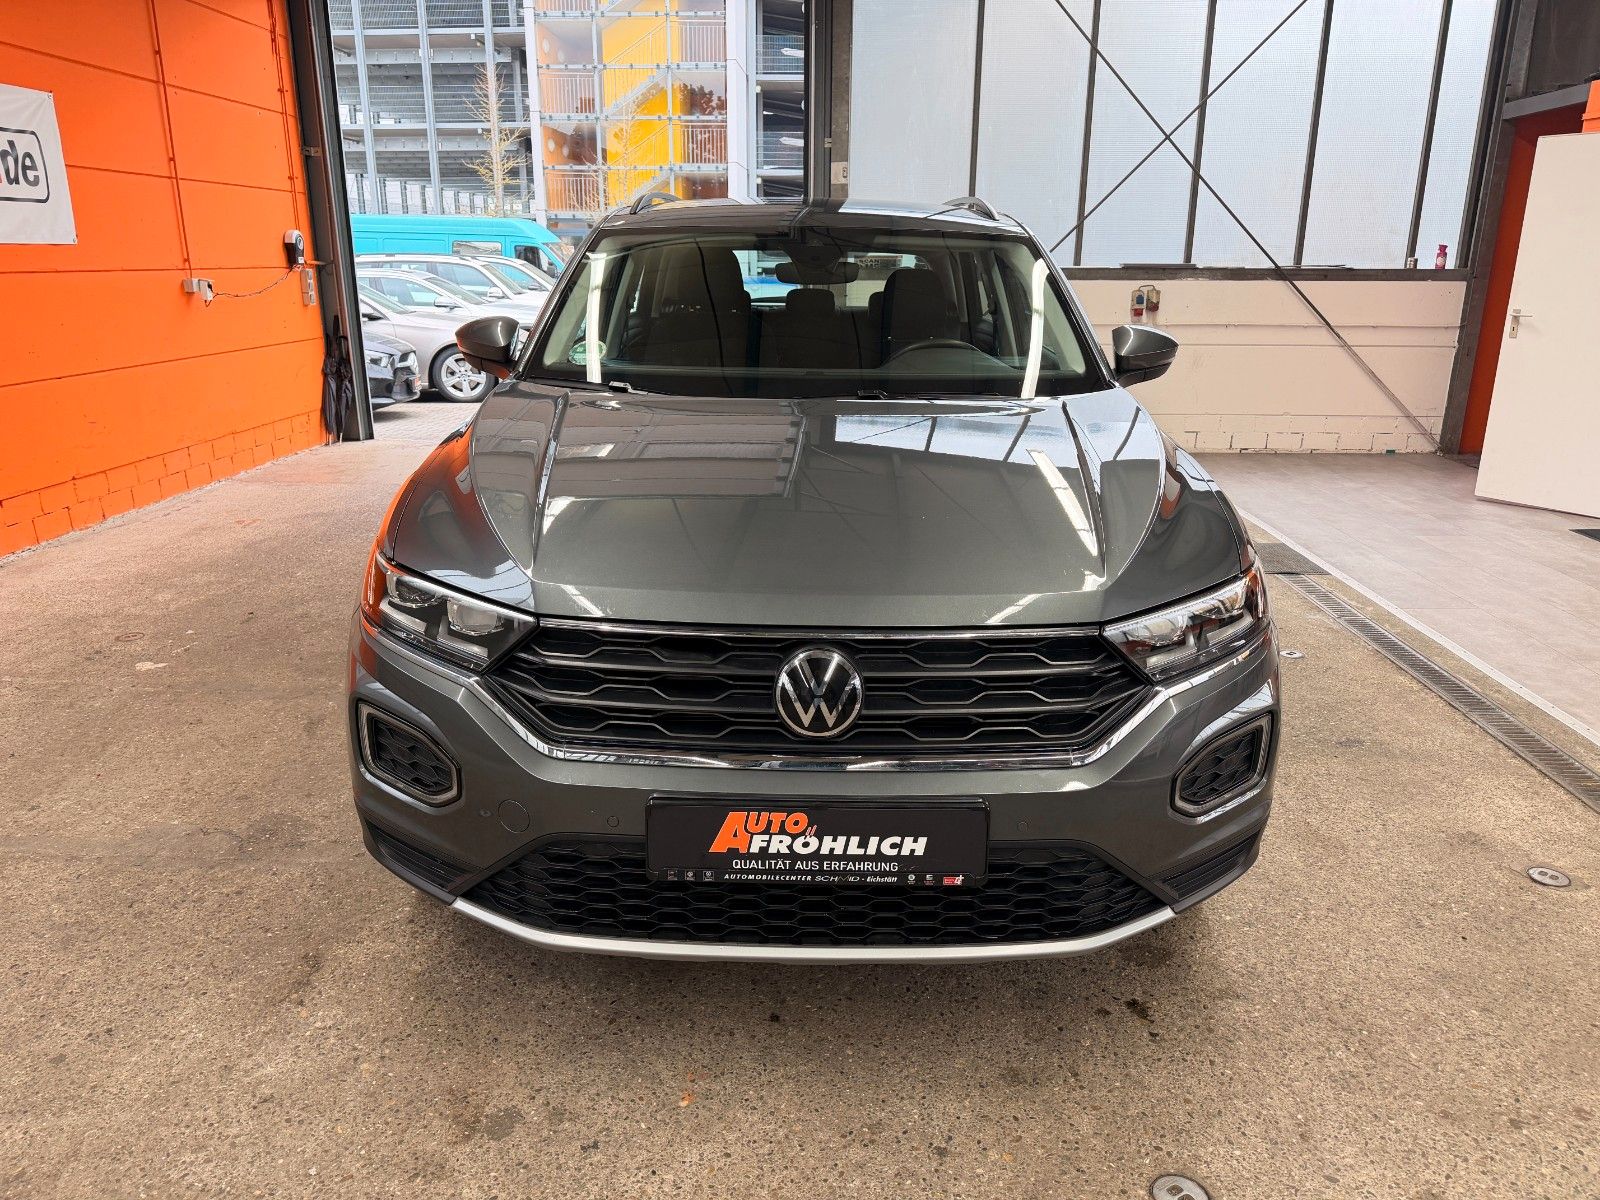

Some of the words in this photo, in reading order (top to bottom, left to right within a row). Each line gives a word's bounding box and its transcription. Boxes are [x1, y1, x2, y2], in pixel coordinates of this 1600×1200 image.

[0, 140, 40, 187] de
[708, 811, 809, 854] AUTO
[749, 825, 928, 857] FRÖHLICH
[723, 873, 812, 882] AUTOMOBILECENTER
[866, 875, 898, 884] Eichstätt
[732, 858, 792, 871] QUALITÄT
[794, 859, 820, 871] AUS
[823, 860, 899, 872] ERFAHRUNG
